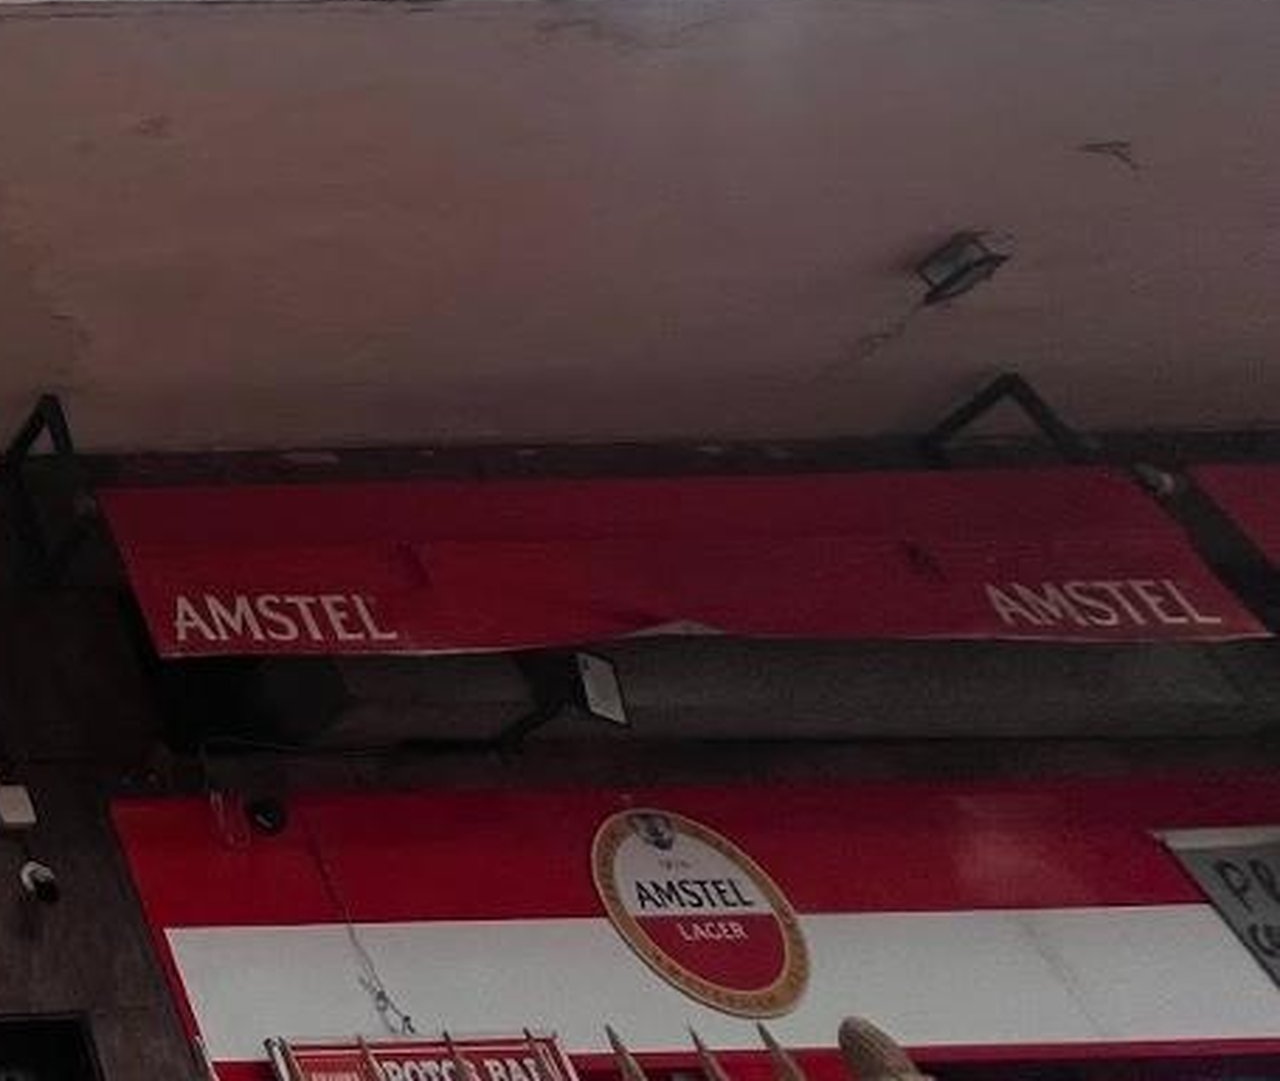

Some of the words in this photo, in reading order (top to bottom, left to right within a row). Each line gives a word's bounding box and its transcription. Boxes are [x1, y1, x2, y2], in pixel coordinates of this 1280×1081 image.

[174, 593, 399, 642] AMSTEL
[985, 578, 1223, 627] AMSTEL
[634, 877, 755, 909] AMSTEL
[679, 920, 750, 942] LAGER
